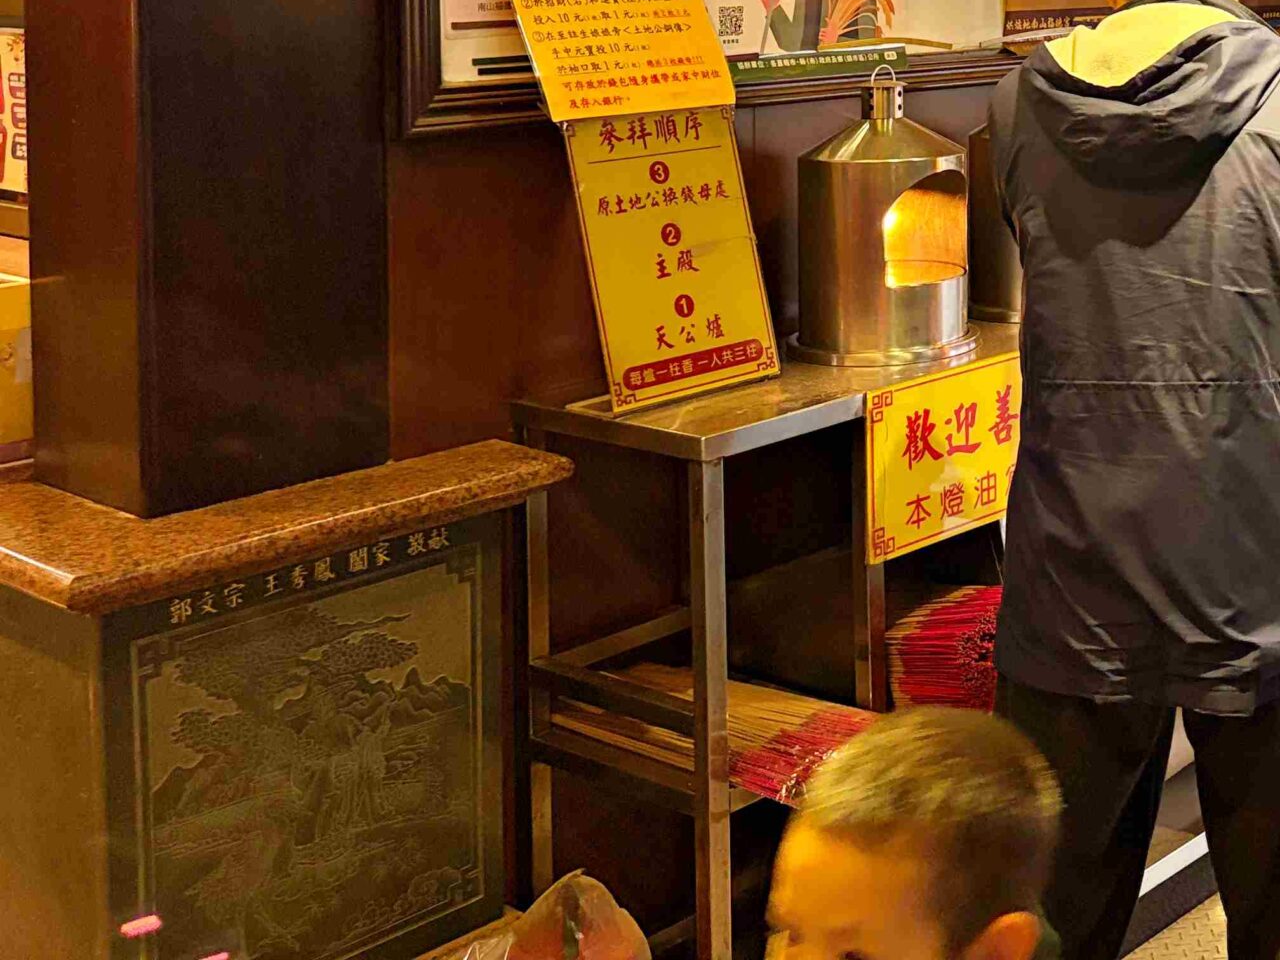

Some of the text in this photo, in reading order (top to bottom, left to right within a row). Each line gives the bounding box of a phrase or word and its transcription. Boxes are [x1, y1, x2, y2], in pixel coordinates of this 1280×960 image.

[598, 110, 703, 155] 參拜順序
[596, 179, 731, 216] 原土地公換錢母處
[654, 248, 700, 279] 主殿
[655, 313, 725, 351] 天公爐
[902, 384, 1019, 471] 歡迎善
[169, 582, 246, 624] 郭文宗
